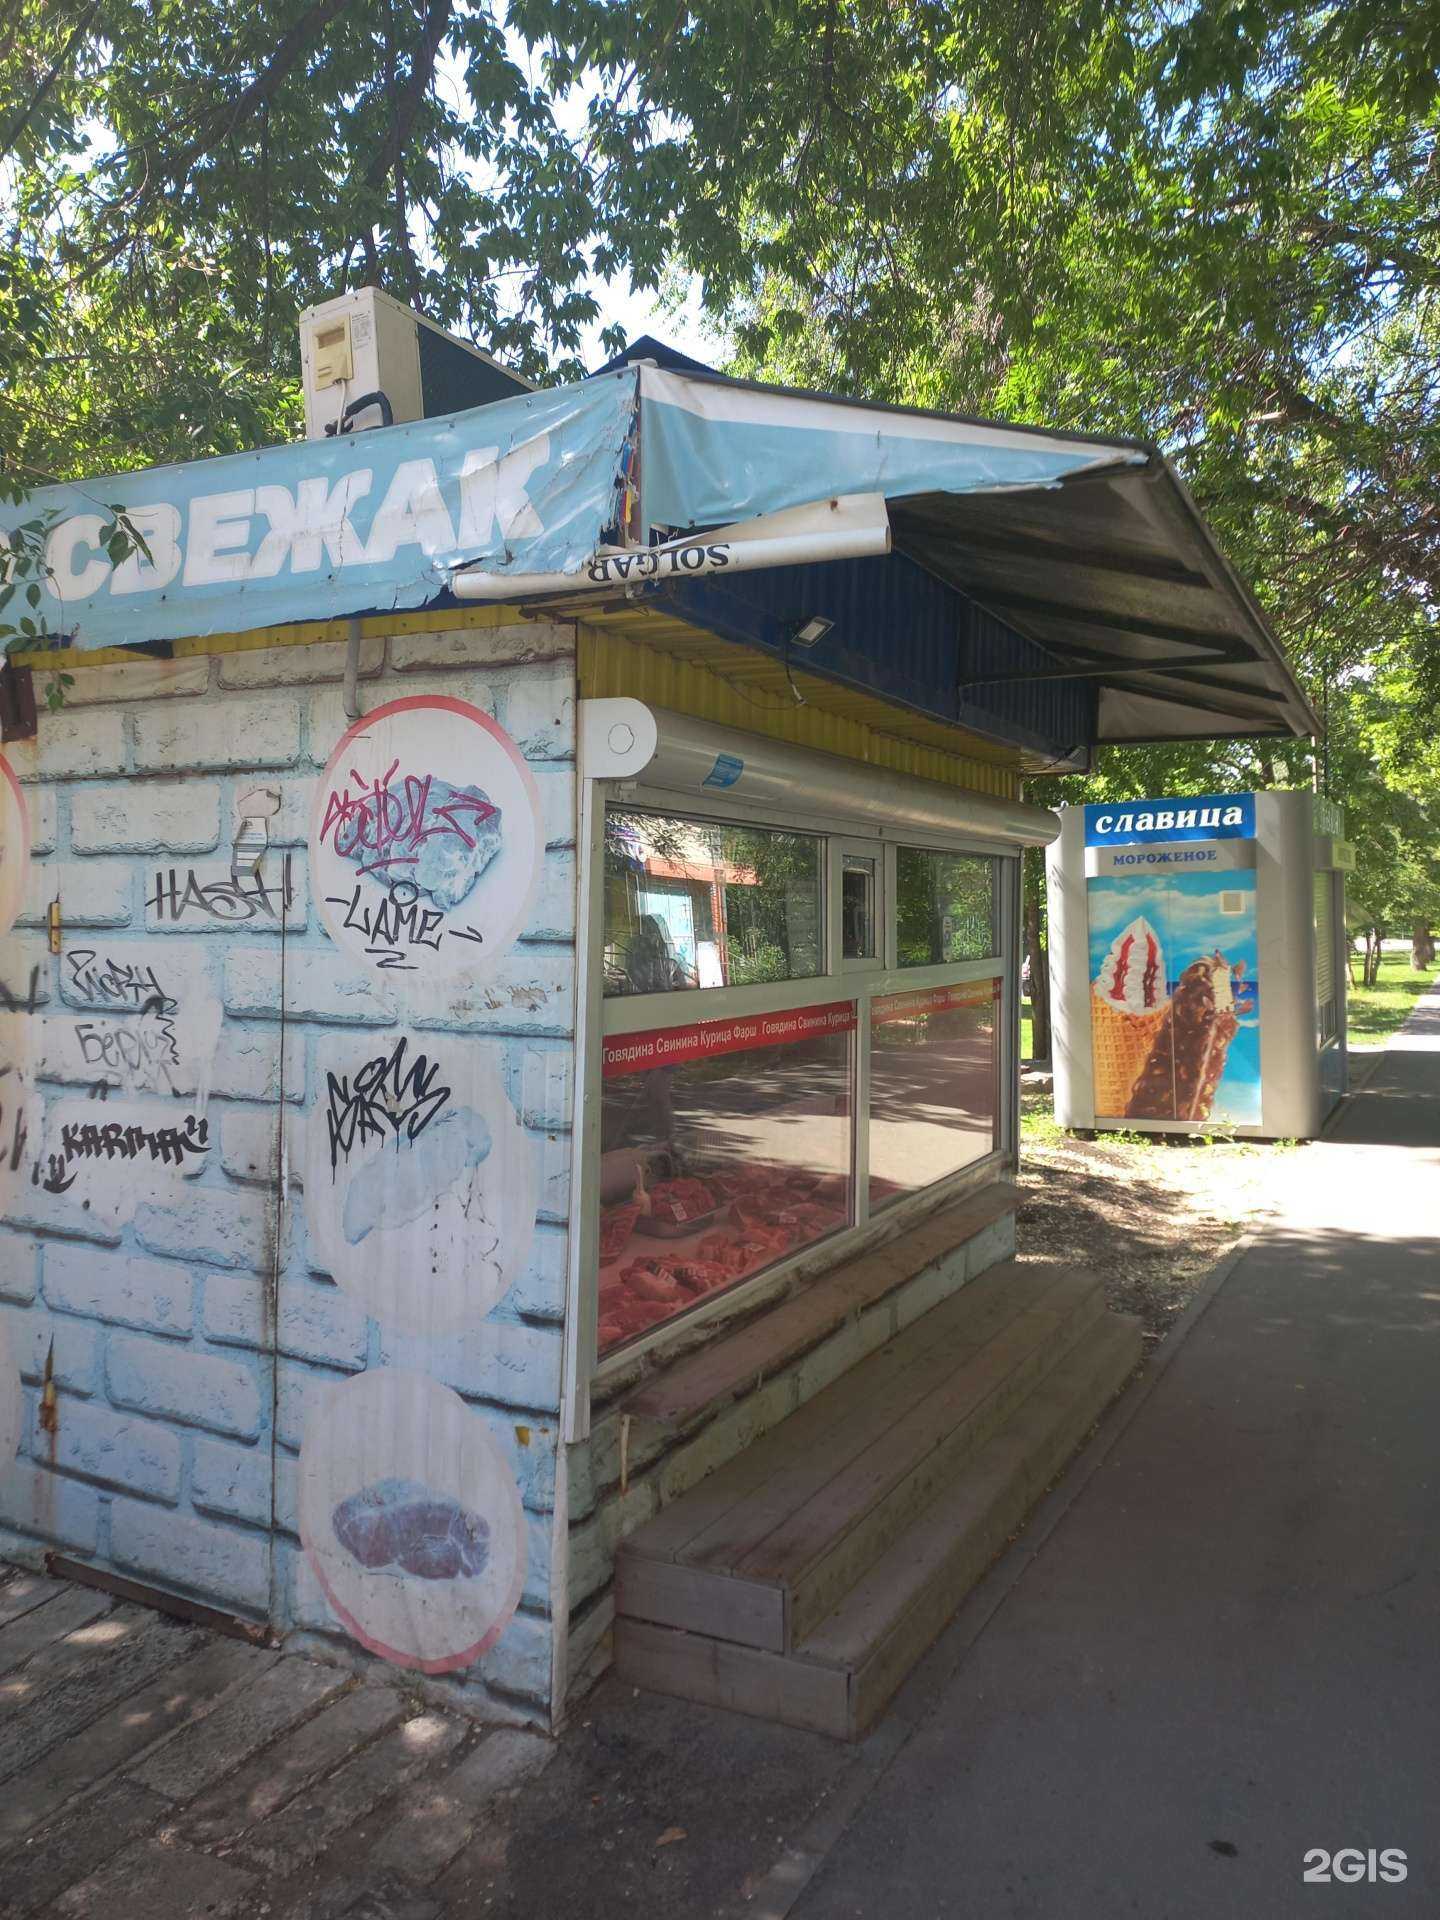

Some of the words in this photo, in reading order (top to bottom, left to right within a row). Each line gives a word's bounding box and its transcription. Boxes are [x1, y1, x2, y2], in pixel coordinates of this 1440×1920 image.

[46, 433, 551, 601] СВЕЖАК
[588, 543, 730, 582] SOLGAR
[1095, 806, 1243, 834] славица
[1113, 850, 1217, 866] МОРОЖЕНОЕ
[602, 1043, 654, 1065] Говядина
[656, 1035, 698, 1054] Свинина
[700, 1029, 732, 1049] Курица
[733, 1024, 757, 1040] Фарш
[762, 1019, 797, 1036] Говядина
